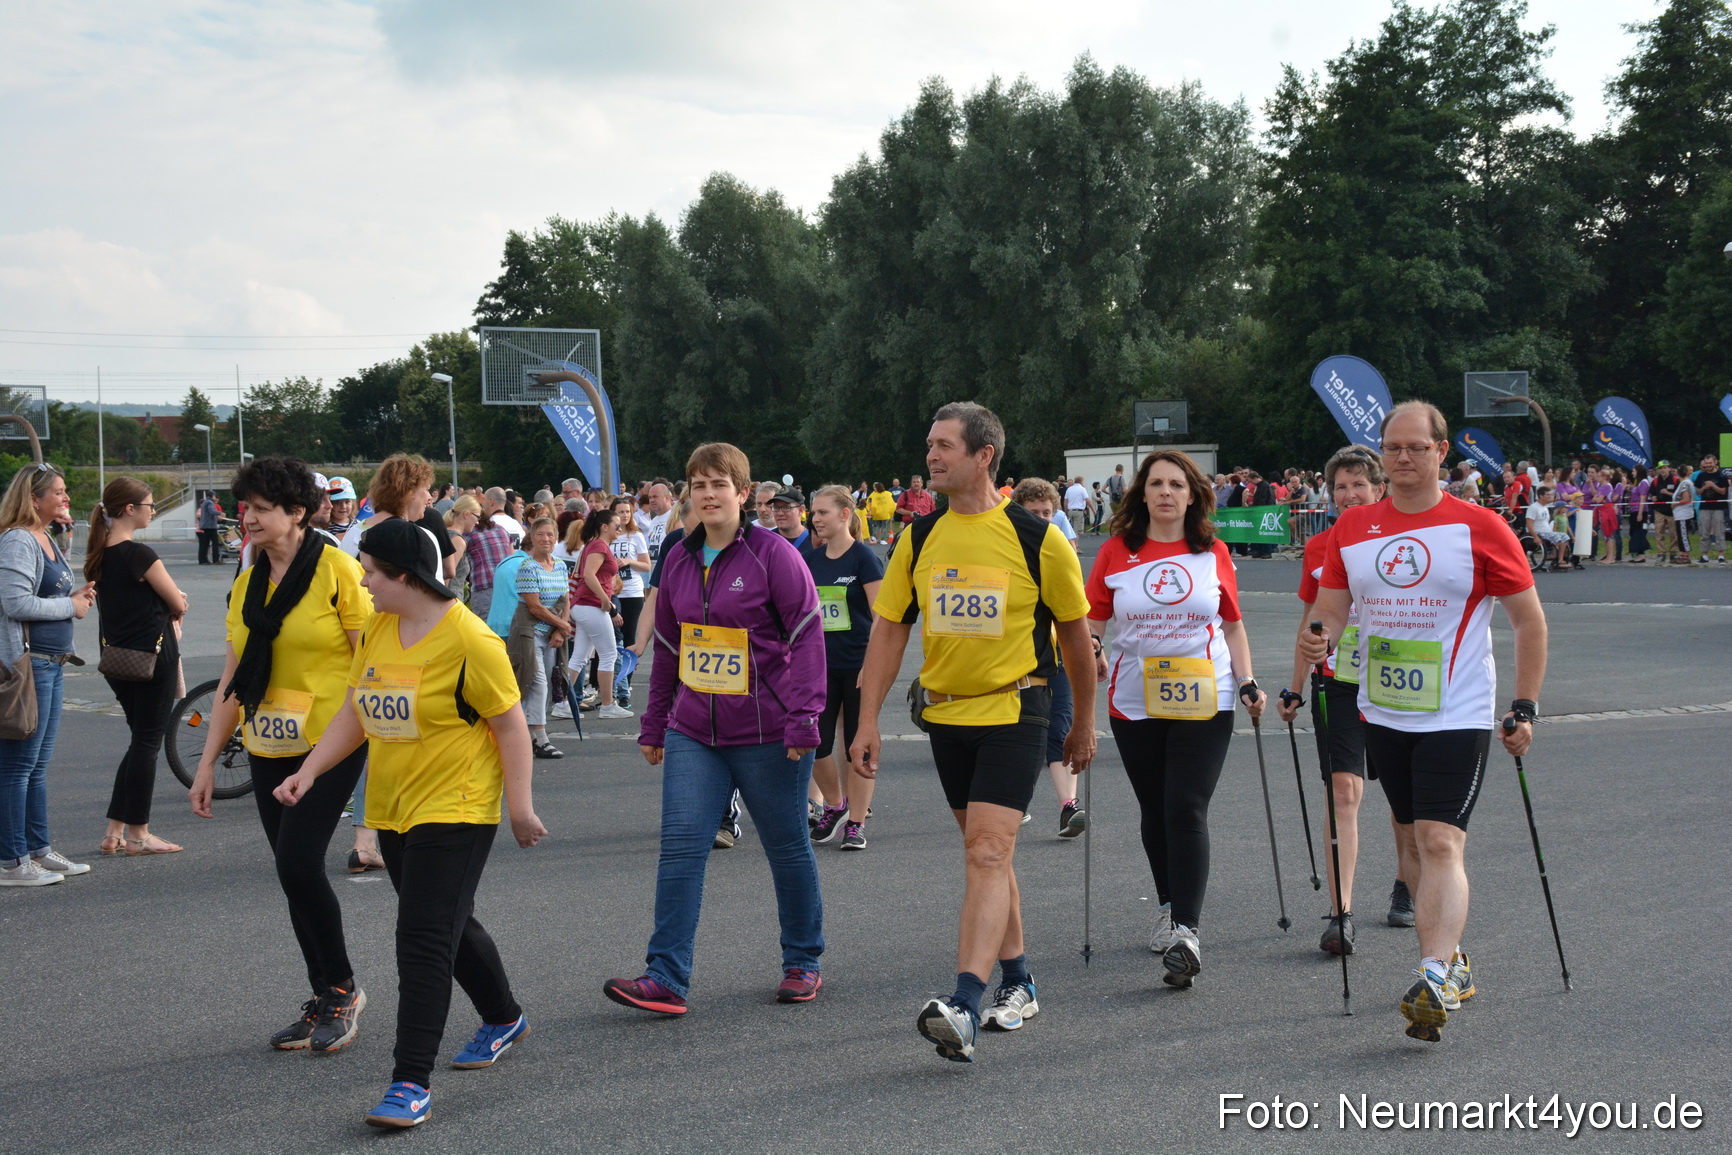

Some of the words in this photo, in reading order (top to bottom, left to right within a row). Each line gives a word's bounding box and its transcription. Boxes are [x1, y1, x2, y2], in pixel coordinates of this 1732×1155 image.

[1259, 512, 1284, 531] AOK
[821, 604, 840, 619] 16
[936, 593, 998, 619] 1283
[1411, 610, 1438, 618] Röschl
[1371, 619, 1435, 630] Leistungsdiagnostik
[687, 650, 741, 676] 1275
[1380, 665, 1424, 692] 530
[1160, 682, 1199, 702] 531
[358, 694, 410, 721] 1260
[247, 716, 299, 740] 1289
